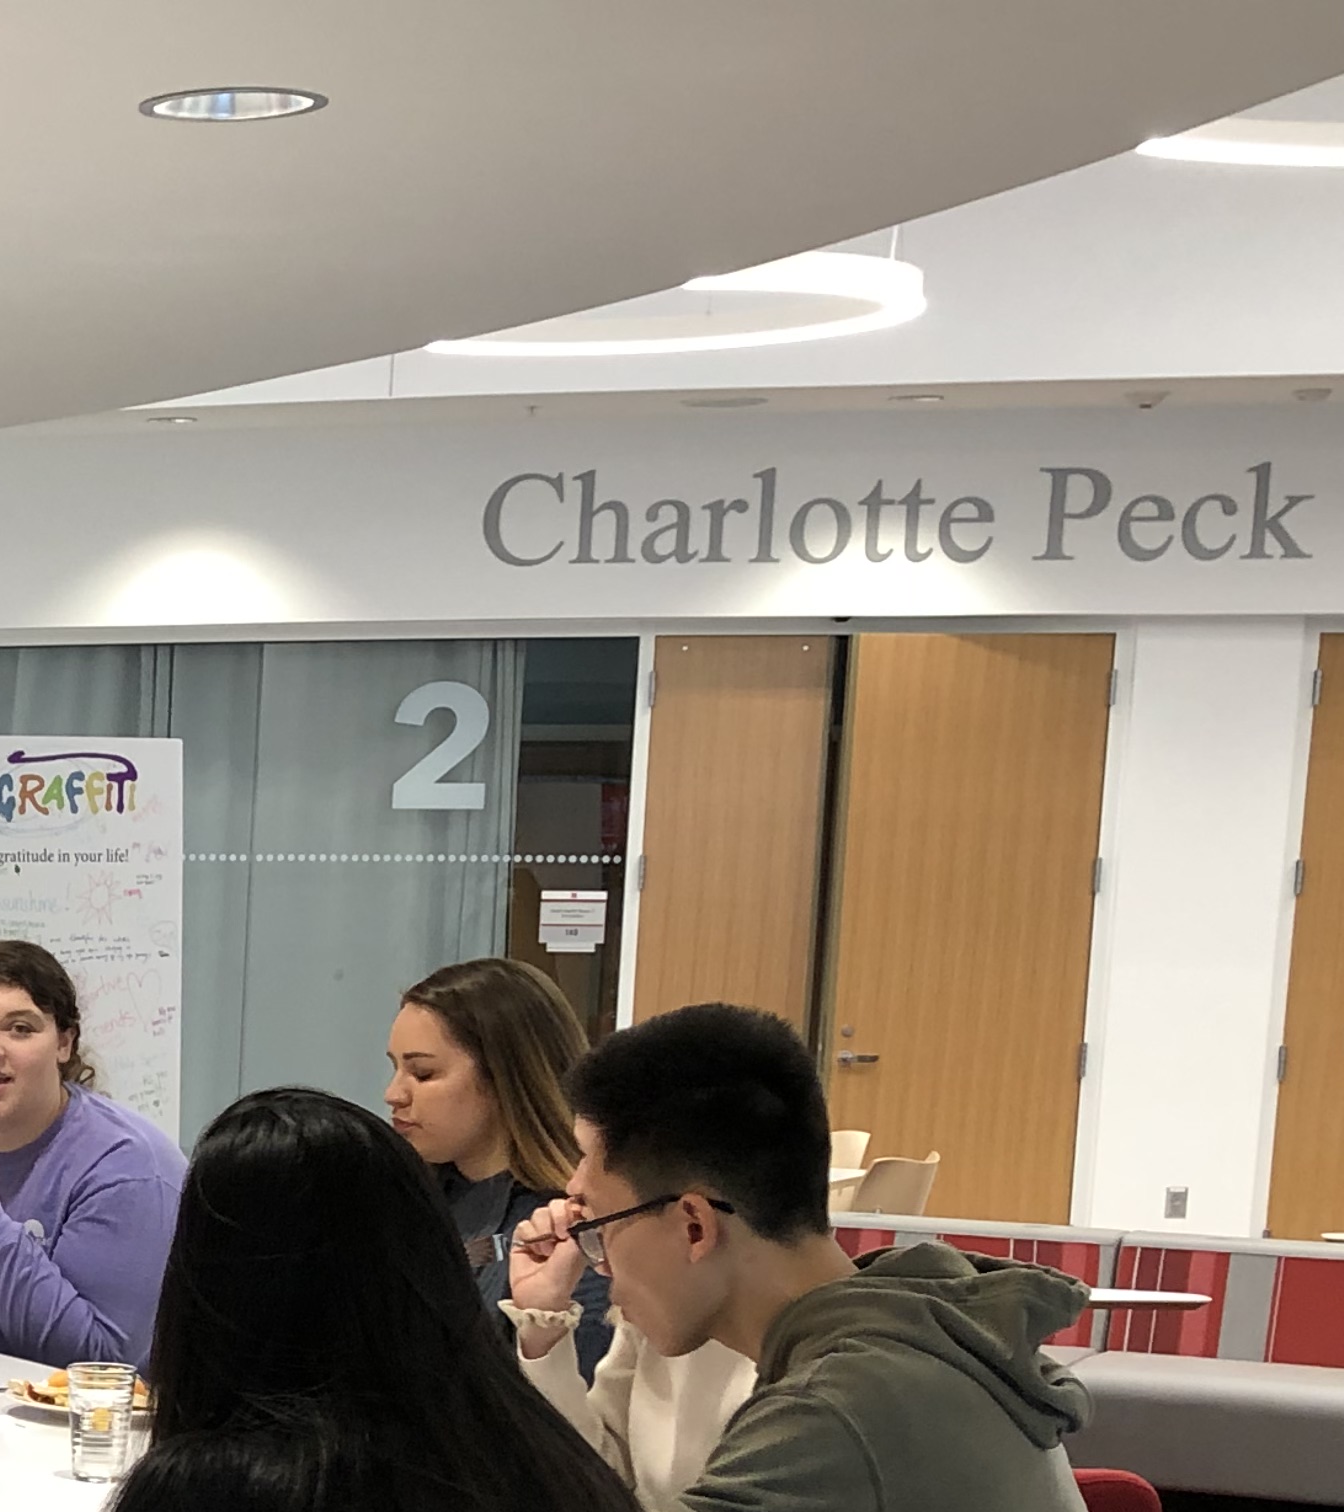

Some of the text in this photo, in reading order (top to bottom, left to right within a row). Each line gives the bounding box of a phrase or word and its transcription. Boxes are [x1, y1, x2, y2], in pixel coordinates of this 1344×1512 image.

[482, 461, 1316, 568] Charlotte Peck
[391, 680, 490, 810] 2
[57, 848, 71, 863] in
[74, 851, 103, 867] your
[106, 848, 129, 863] life!
